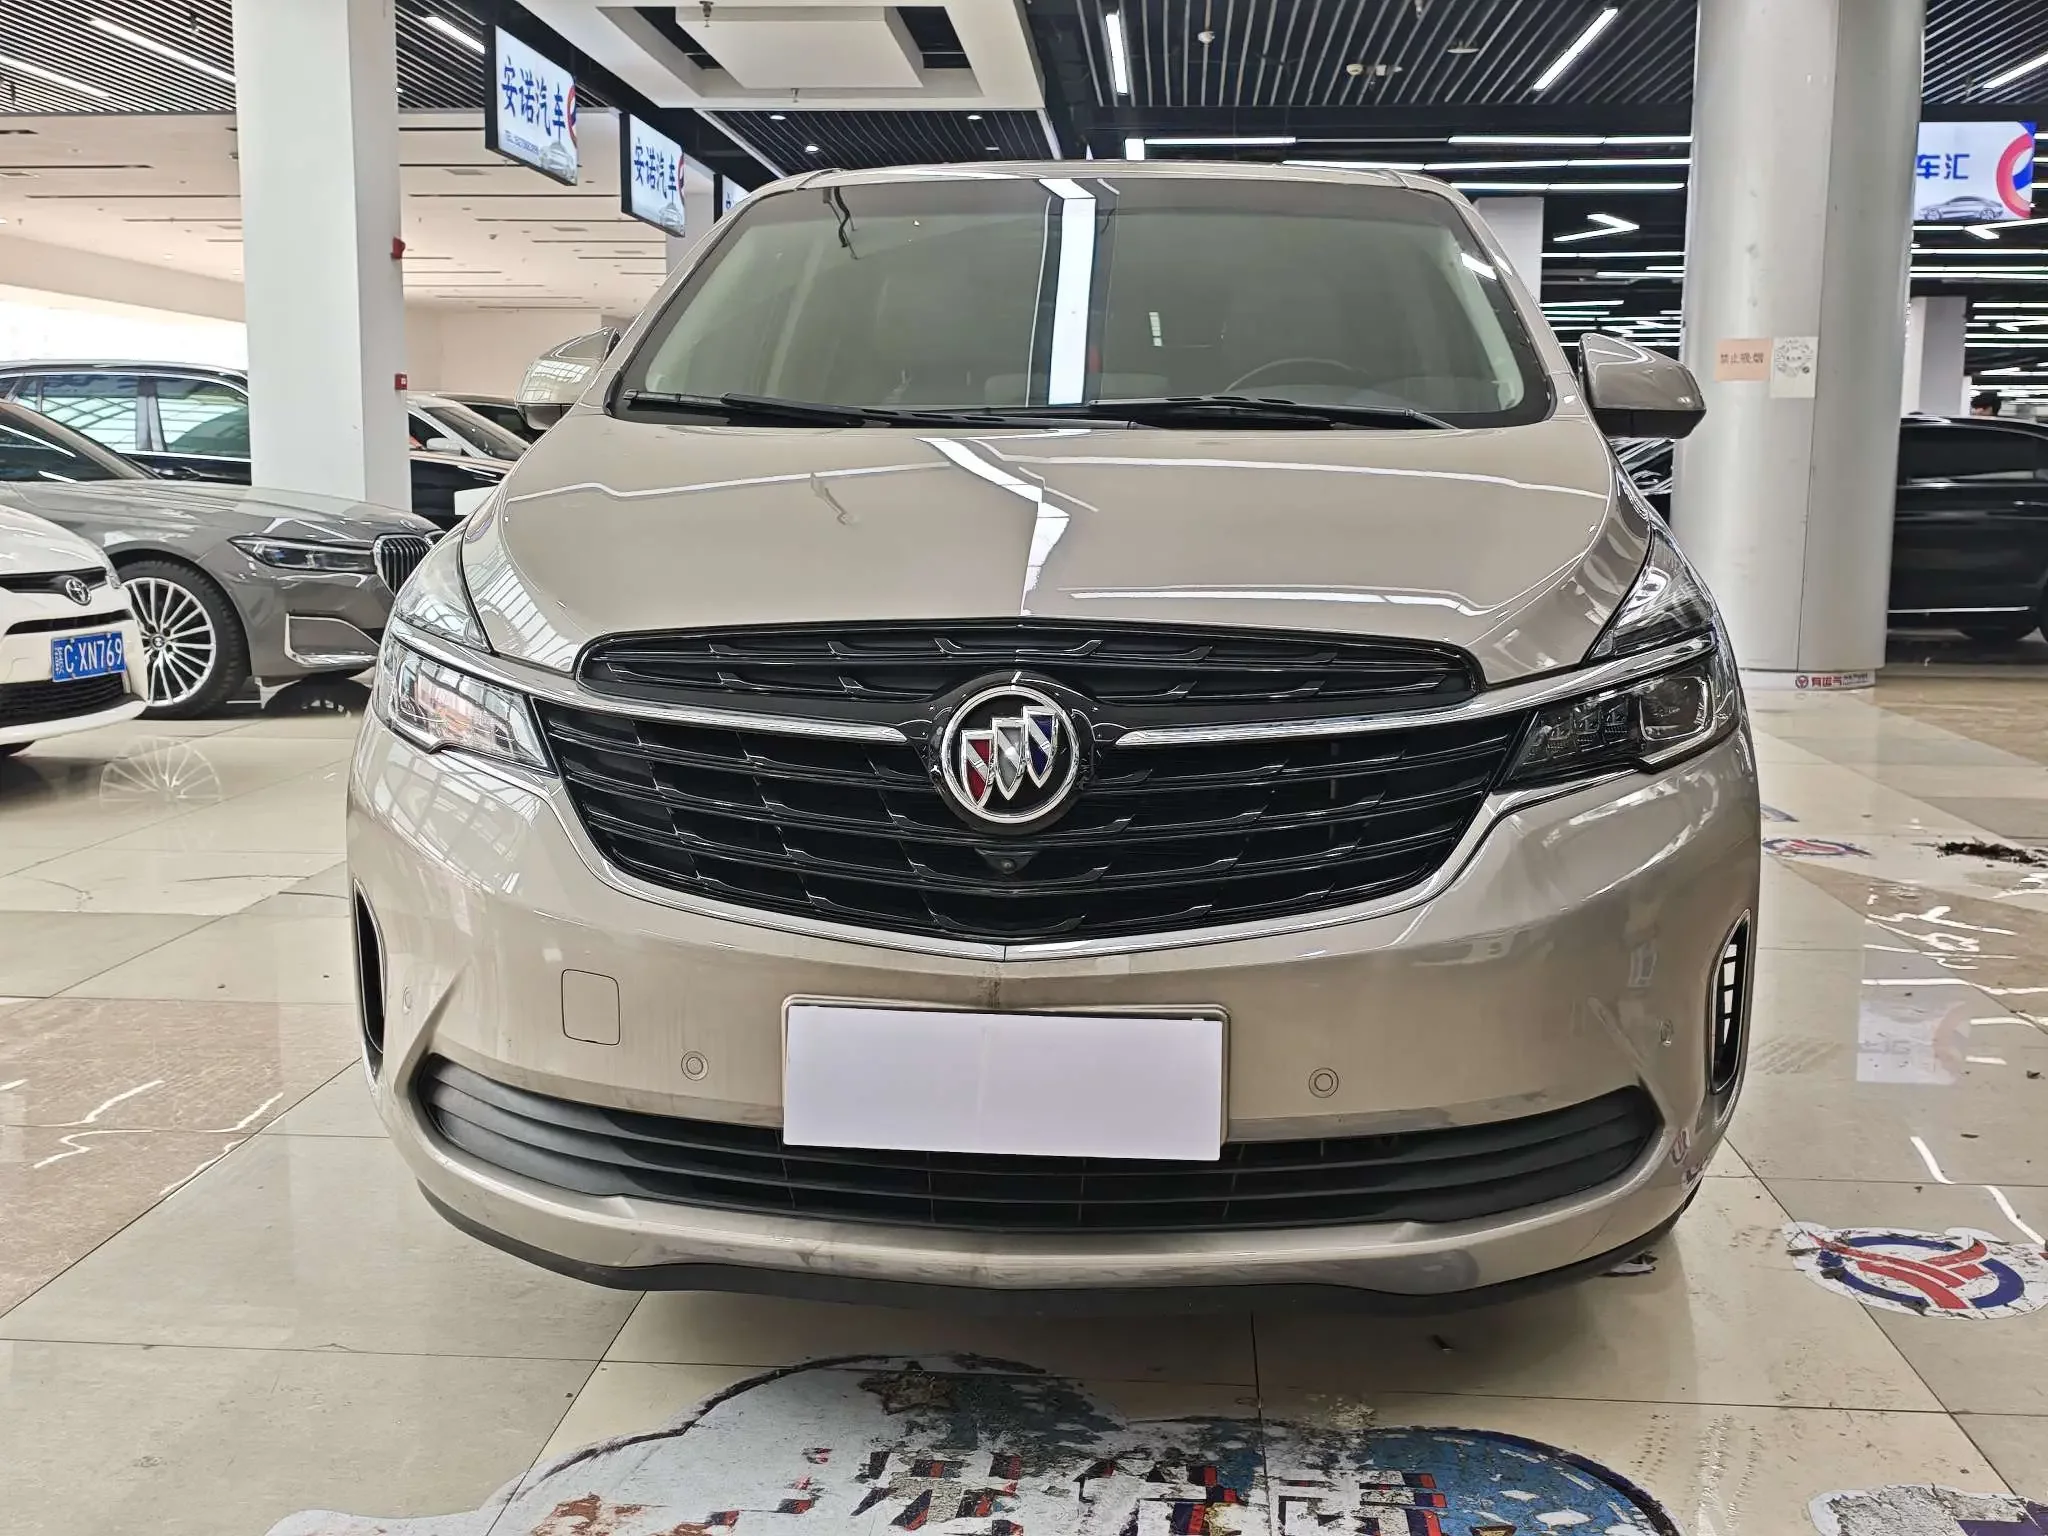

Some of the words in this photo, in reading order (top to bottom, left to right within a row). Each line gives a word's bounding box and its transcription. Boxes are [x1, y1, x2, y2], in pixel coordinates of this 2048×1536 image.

[501, 54, 566, 143] 安诺汽车
[633, 137, 677, 204] 安诺汽车
